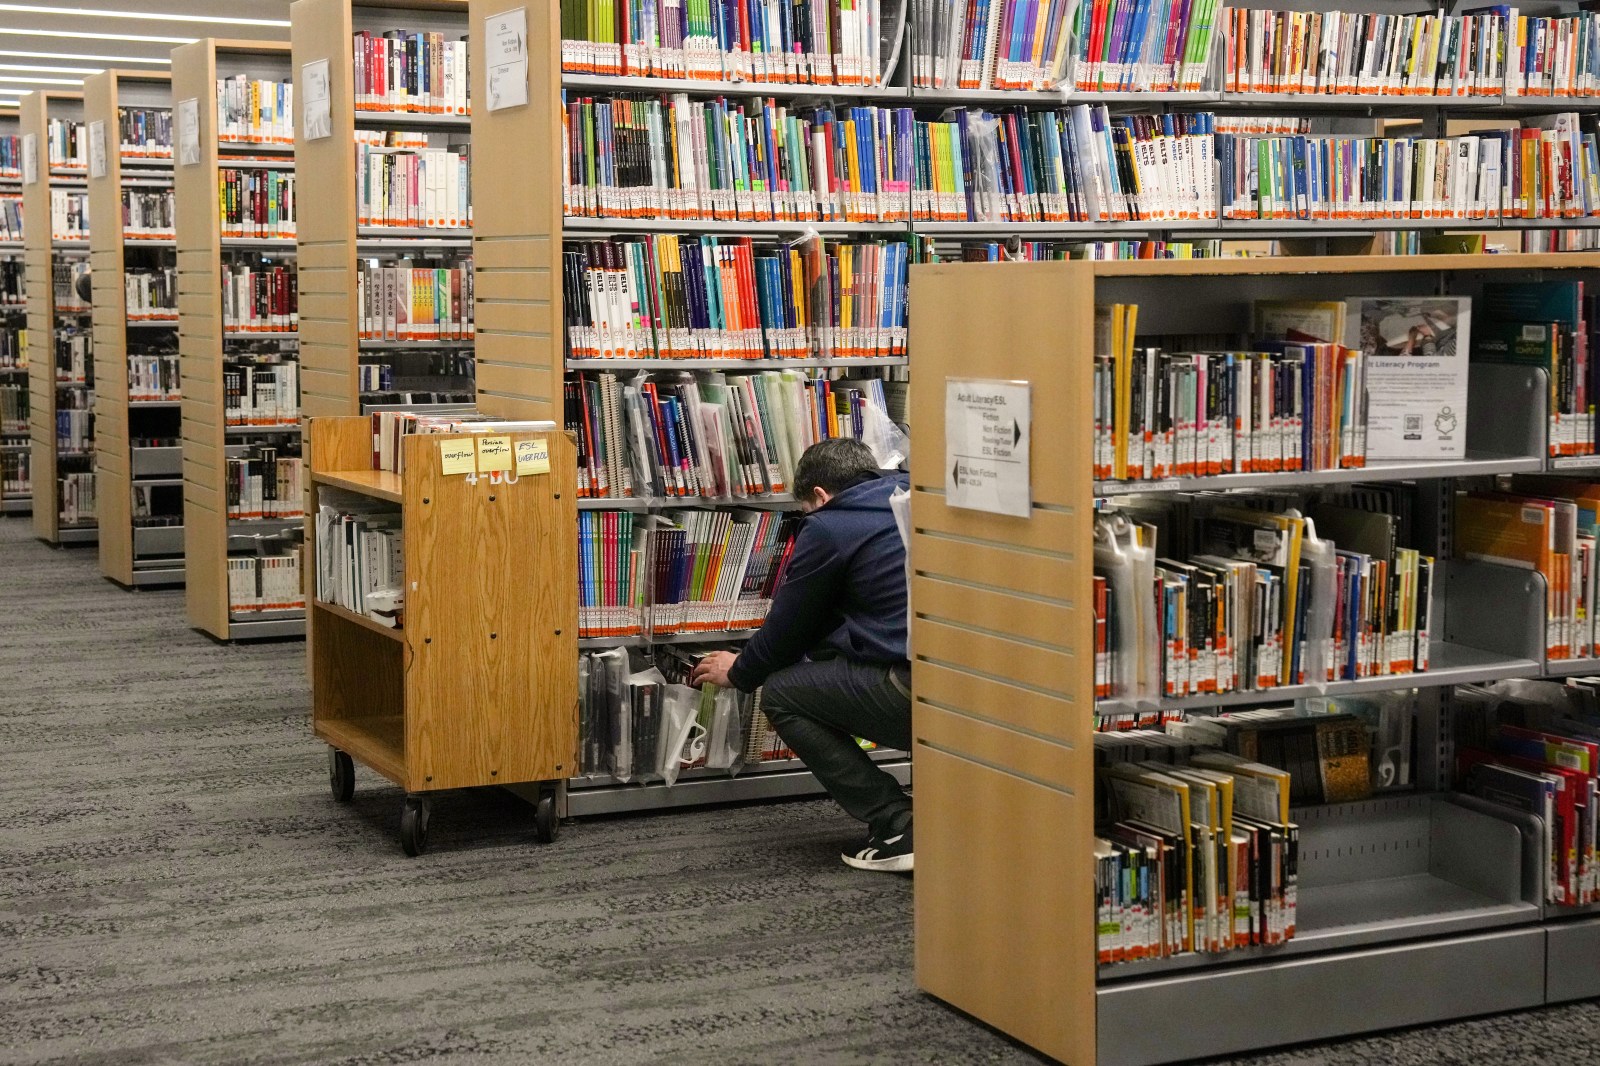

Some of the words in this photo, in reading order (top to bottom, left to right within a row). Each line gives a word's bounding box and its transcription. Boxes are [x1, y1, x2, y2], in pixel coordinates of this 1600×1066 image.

[1141, 144, 1149, 166] IELTS
[1376, 361, 1405, 369] Literacy
[1407, 361, 1440, 369] Program
[983, 412, 999, 421] Fiction
[993, 425, 1011, 435] Fiction
[482, 446, 509, 455] overflow
[519, 442, 538, 451] ESL
[445, 451, 474, 460] overflow
[982, 446, 992, 455] ESL
[993, 447, 1011, 457] Fiction
[959, 466, 968, 475] ESL
[980, 469, 997, 478] Fiction
